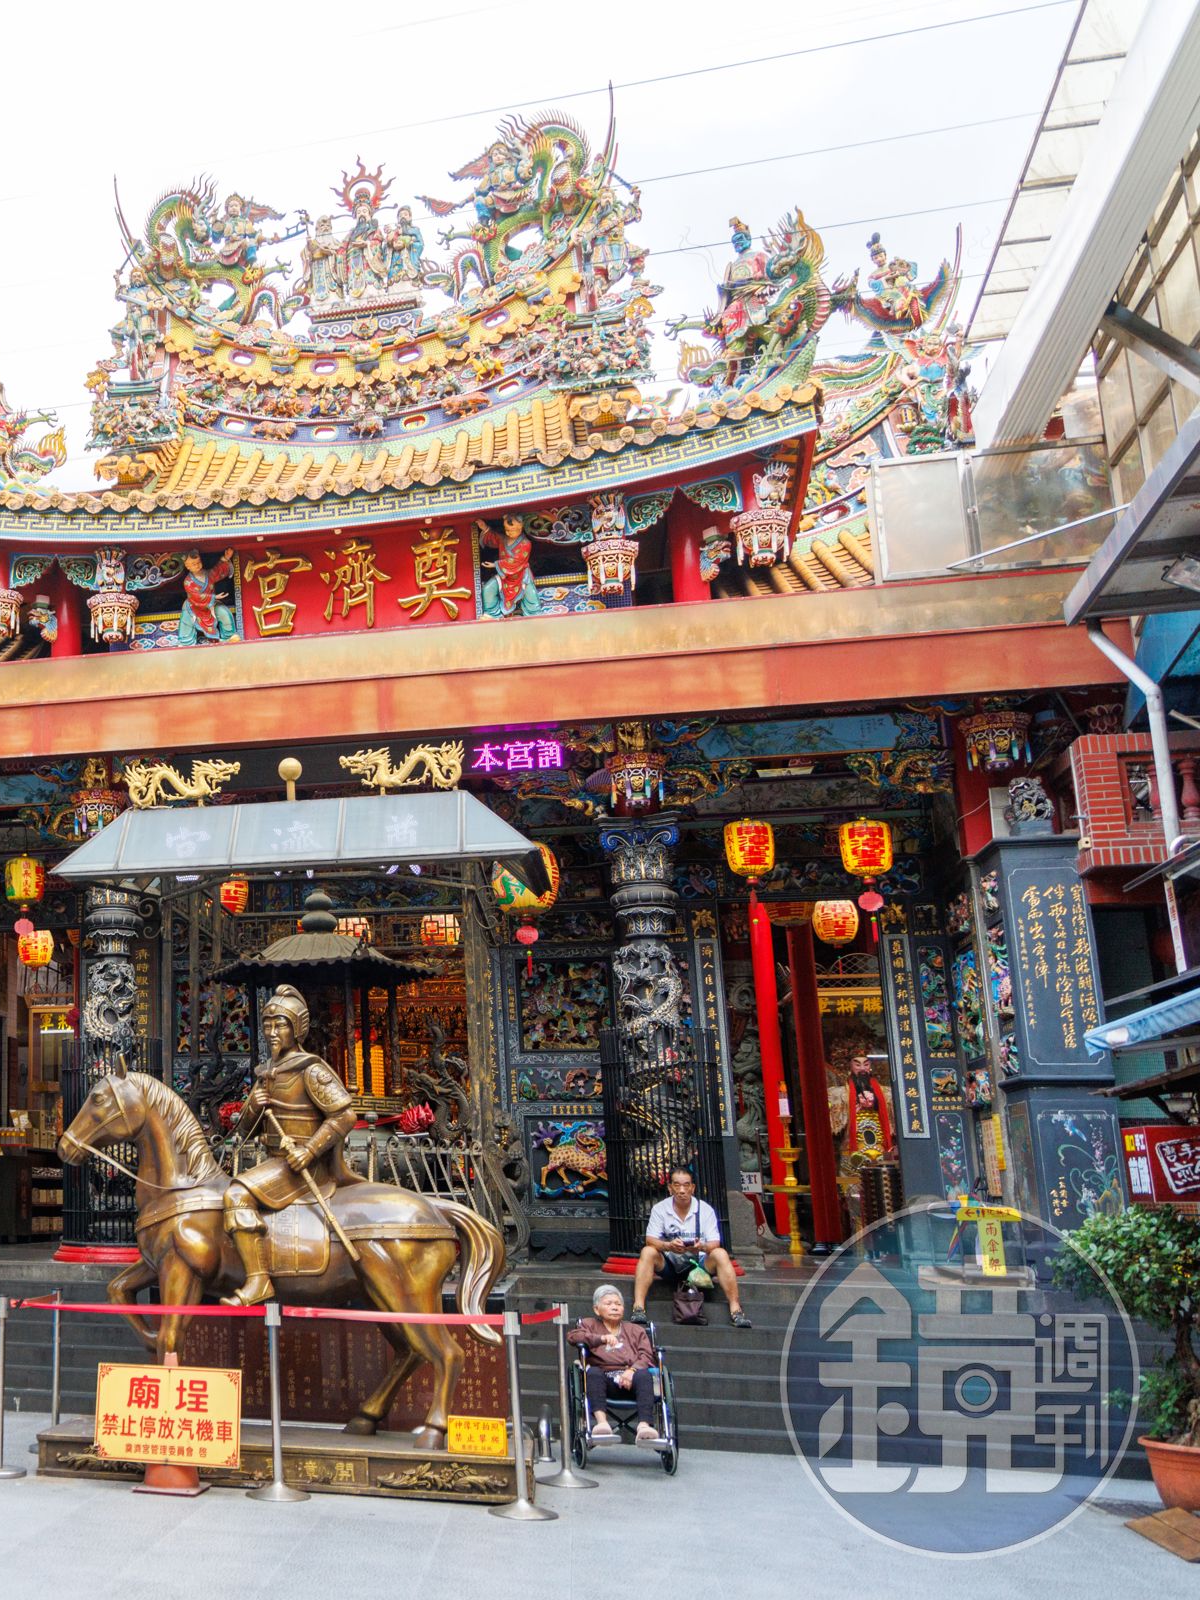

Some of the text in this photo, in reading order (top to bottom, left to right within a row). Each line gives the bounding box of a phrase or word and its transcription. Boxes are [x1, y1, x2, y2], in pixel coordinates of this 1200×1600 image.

[127, 1375, 209, 1413] 廟埕
[102, 1413, 233, 1444] 禁止停放汽機車
